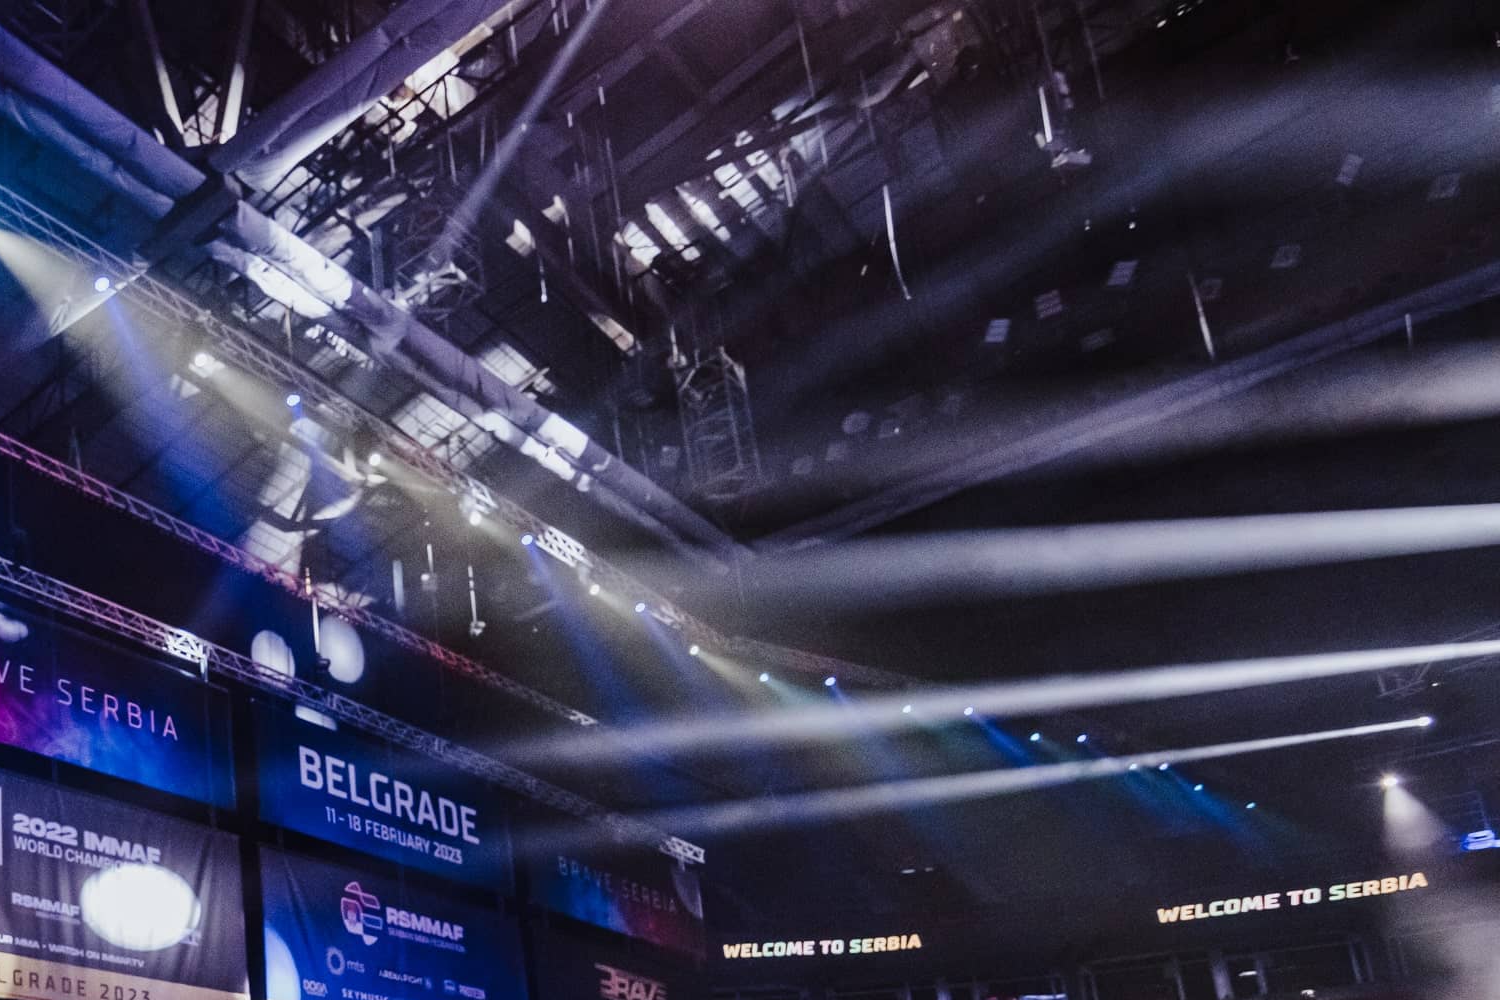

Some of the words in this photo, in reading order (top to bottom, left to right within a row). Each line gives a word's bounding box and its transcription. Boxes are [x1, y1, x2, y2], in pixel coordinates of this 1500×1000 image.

[57, 678, 180, 742] SERBIA
[298, 745, 480, 845] BELGRADE
[12, 813, 78, 846] 2022
[83, 830, 161, 866] IMMAF
[13, 835, 63, 859] WORLD
[325, 806, 336, 824] 11
[347, 813, 362, 832] 18
[364, 819, 430, 854] FEBRUARY
[432, 841, 463, 865] 2023
[11, 892, 80, 918] RSMMAF
[557, 855, 613, 893] BRAVE
[620, 879, 677, 913] SERBIA
[1156, 893, 1280, 924] WELCOME
[1286, 887, 1322, 906] TO
[1328, 871, 1428, 901] SERBIA
[385, 906, 464, 941] RSMMAF
[722, 938, 815, 961] WELCOME
[819, 938, 845, 956] TO
[848, 932, 924, 955] SERBIA
